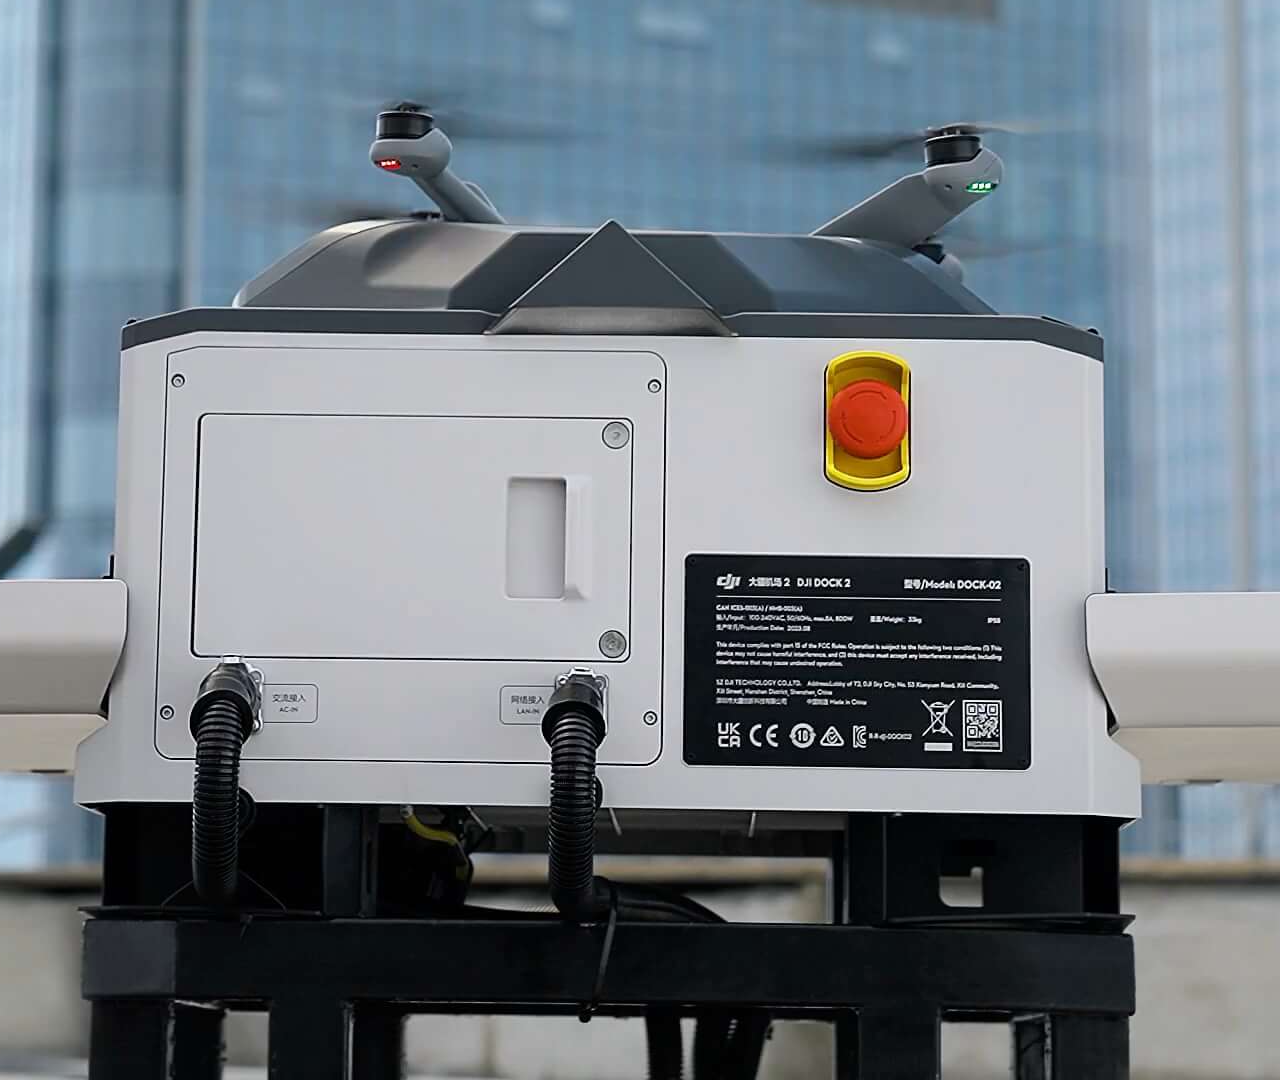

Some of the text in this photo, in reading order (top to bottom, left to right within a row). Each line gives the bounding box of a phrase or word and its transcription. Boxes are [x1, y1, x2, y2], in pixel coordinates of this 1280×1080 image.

[784, 577, 791, 587] 2
[797, 578, 851, 588] DJI DOCK 2
[957, 579, 1001, 589] DOCK-02
[717, 723, 740, 735] UK
[749, 723, 779, 748] CE
[717, 736, 741, 748] CA
